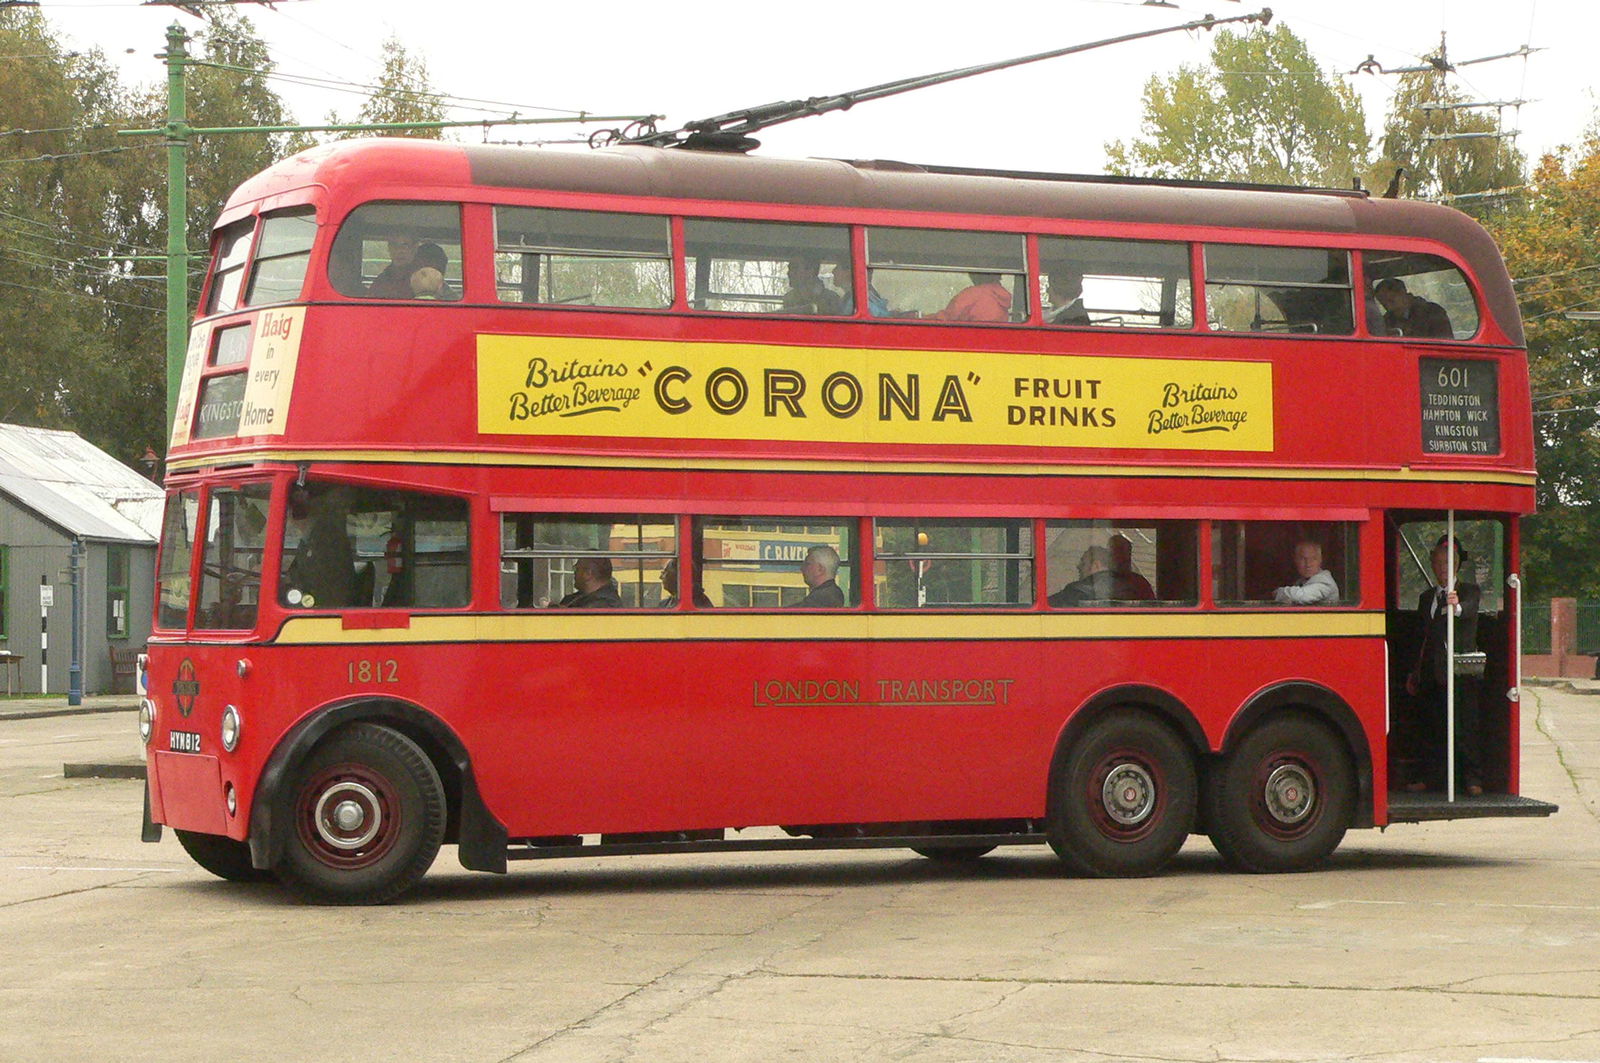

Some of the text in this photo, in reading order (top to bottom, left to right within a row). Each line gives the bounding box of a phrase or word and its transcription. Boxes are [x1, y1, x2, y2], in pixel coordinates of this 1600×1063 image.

[261, 312, 293, 340] Haig
[266, 343, 275, 360] in
[254, 369, 280, 389] every
[525, 357, 628, 389] Britains
[1437, 366, 1468, 388] 601
[1014, 376, 1102, 400] FRUIT
[1162, 382, 1238, 408] Britains
[1428, 393, 1481, 407] TEDDINGTON
[509, 381, 641, 421] Better Beverage
[243, 401, 275, 427] Home
[1007, 404, 1117, 428] DRINKS
[1147, 404, 1248, 435] Better Beverage
[1423, 409, 1489, 422] HAMPTON WICK
[1435, 425, 1479, 437] KINGSTON
[1429, 440, 1488, 452] SURBITON STN
[347, 659, 400, 684] 1812
[752, 679, 1015, 707] LONDON TRANSPORT
